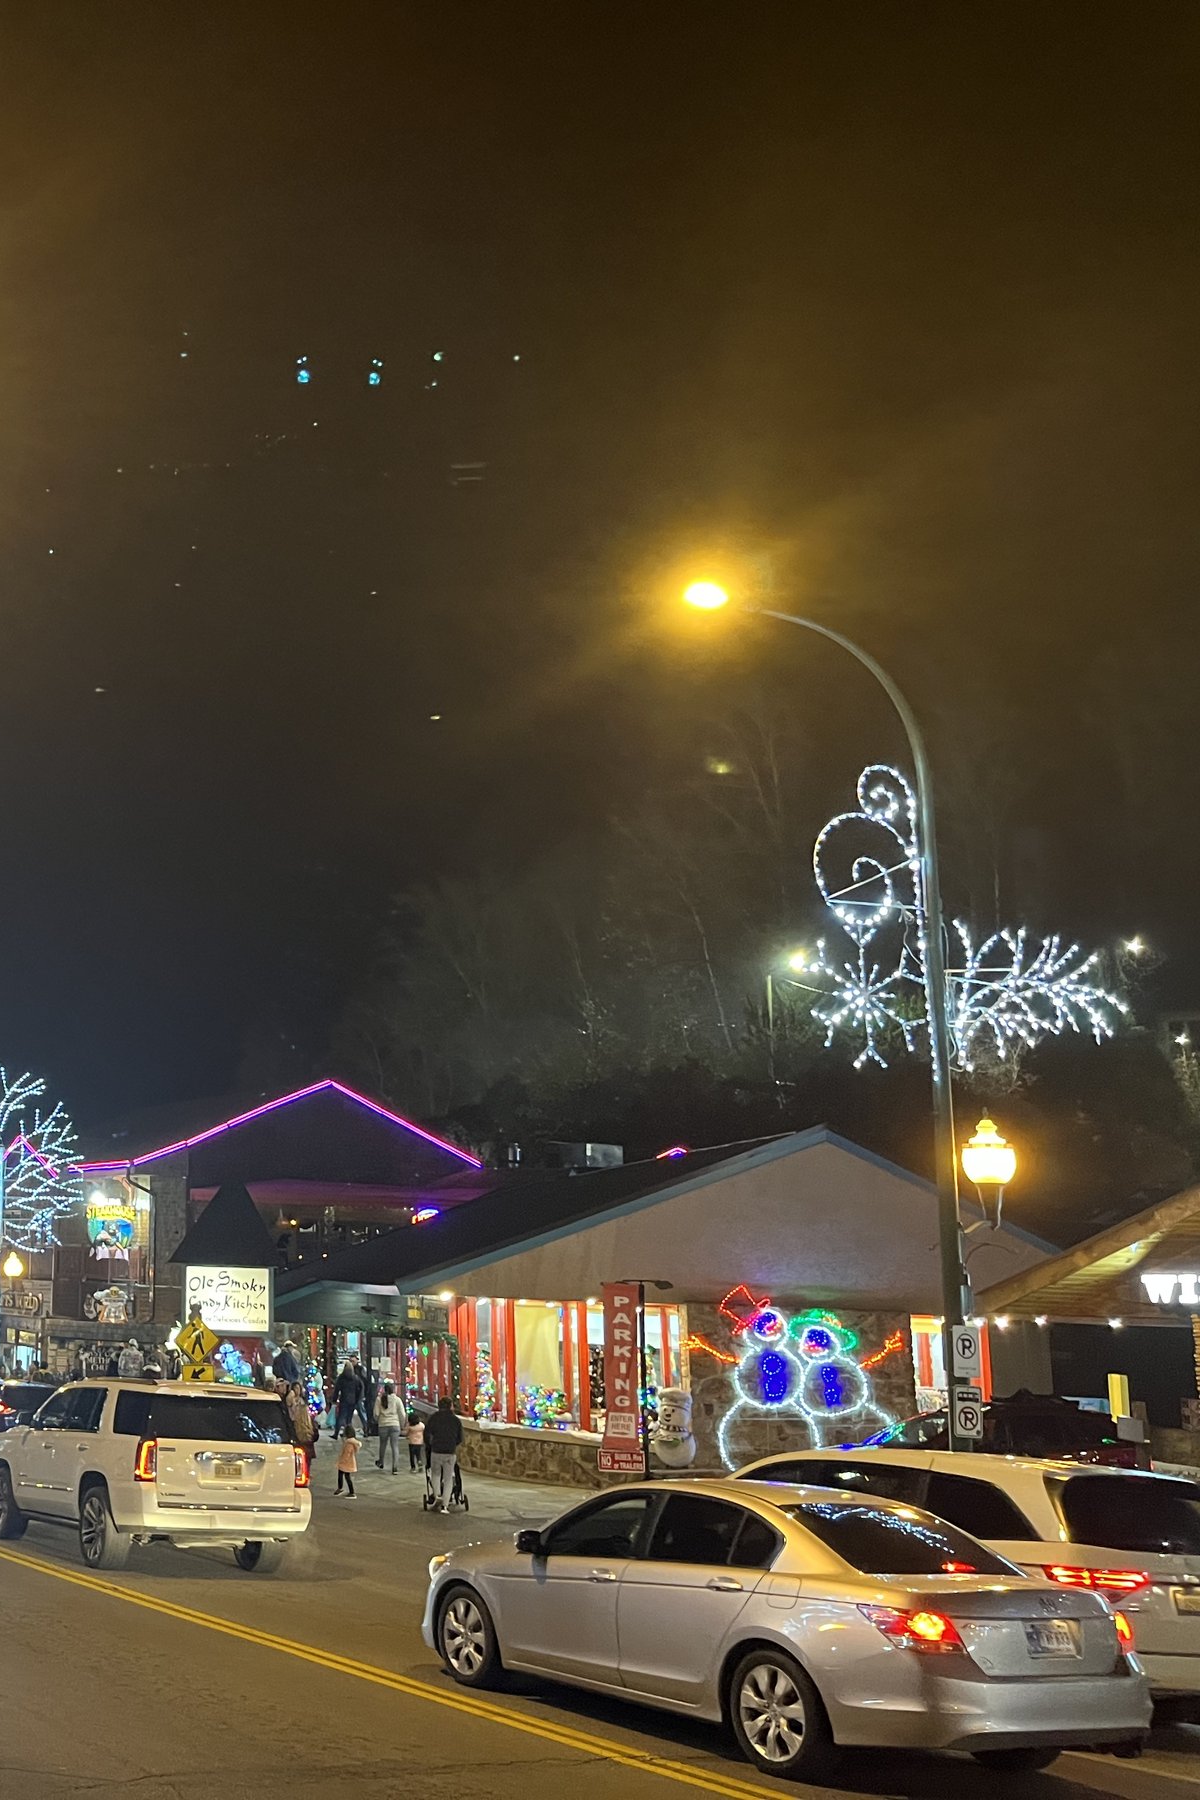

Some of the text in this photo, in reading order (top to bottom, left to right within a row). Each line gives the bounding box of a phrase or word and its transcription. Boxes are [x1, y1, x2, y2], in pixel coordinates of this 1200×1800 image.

[189, 1270, 266, 1299] Ole Smoky
[1141, 1274, 1200, 1304] WI
[221, 1295, 266, 1315] Kitchen
[612, 1295, 632, 1407] PARKING
[611, 1414, 634, 1423] ENTER
[611, 1423, 631, 1431] HERE
[601, 1455, 612, 1466] NO
